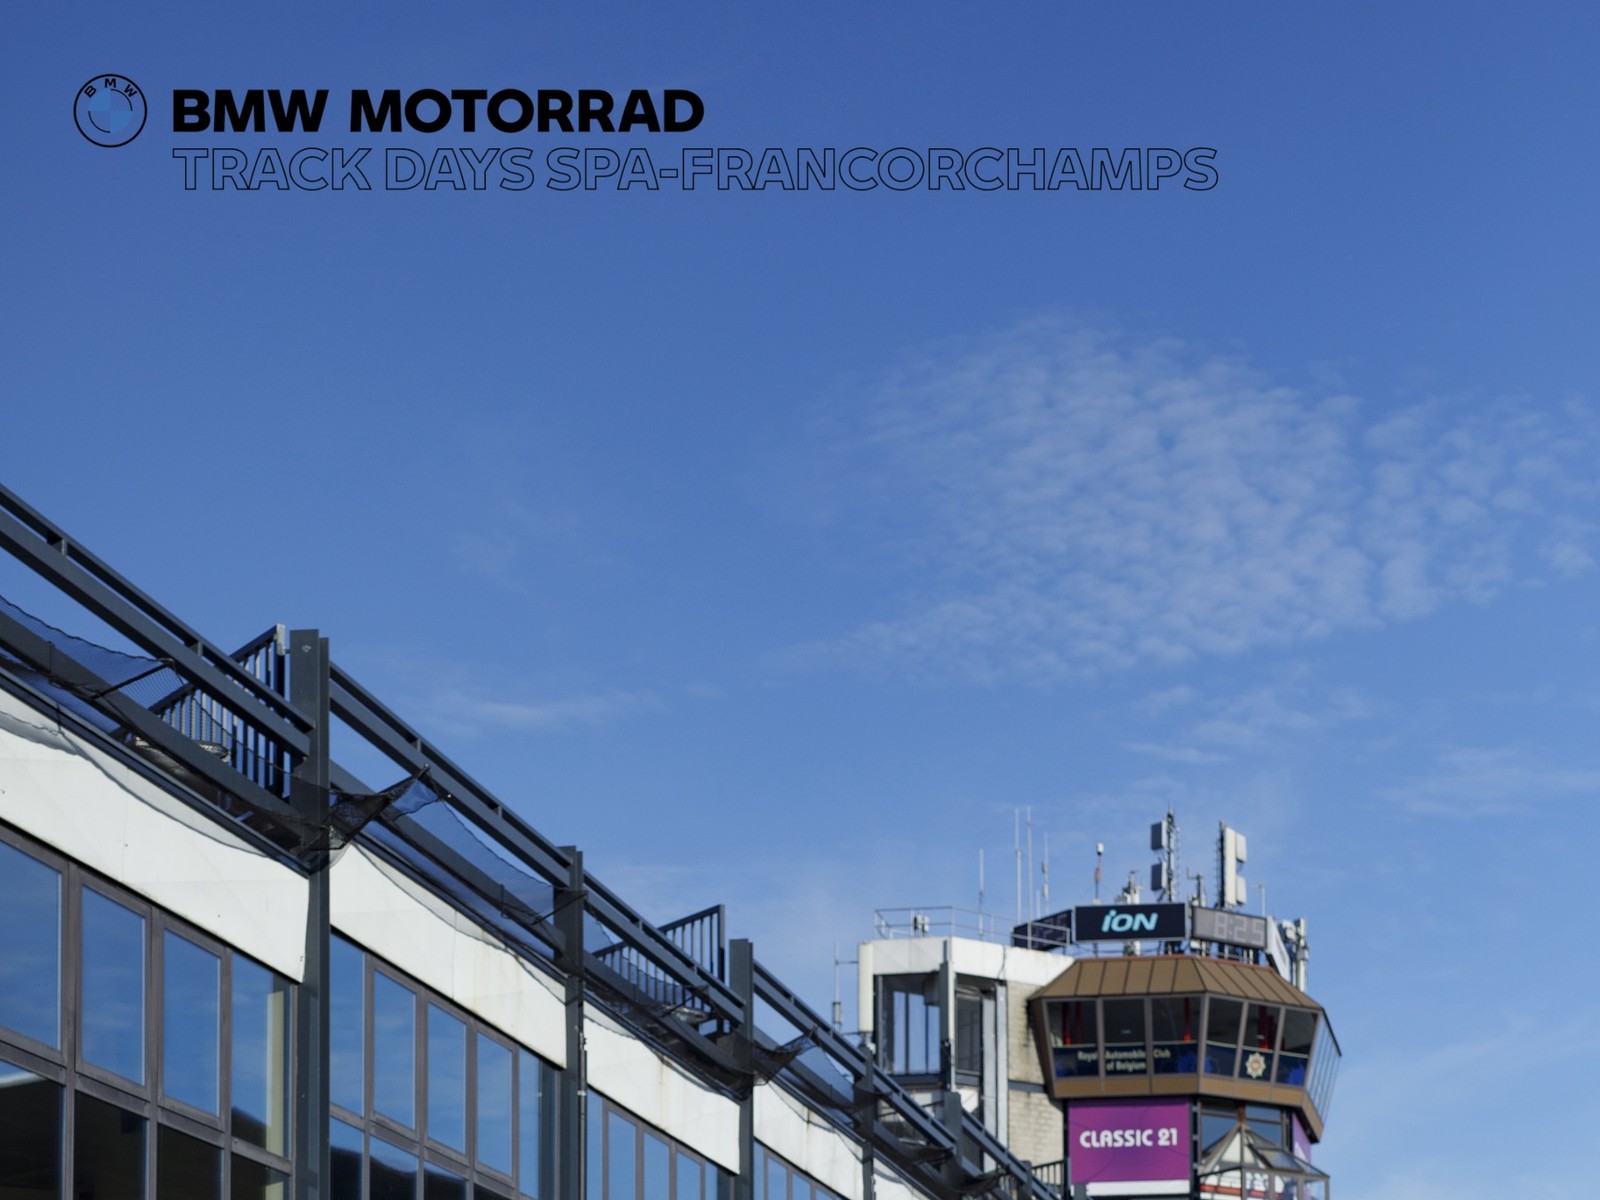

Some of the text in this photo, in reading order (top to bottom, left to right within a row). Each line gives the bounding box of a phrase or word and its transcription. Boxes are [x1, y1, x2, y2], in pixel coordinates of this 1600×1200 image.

[1153, 1049, 1171, 1058] Club
[1106, 1061, 1146, 1073] of Belgium
[1079, 1128, 1177, 1148] CLASSIC 21
